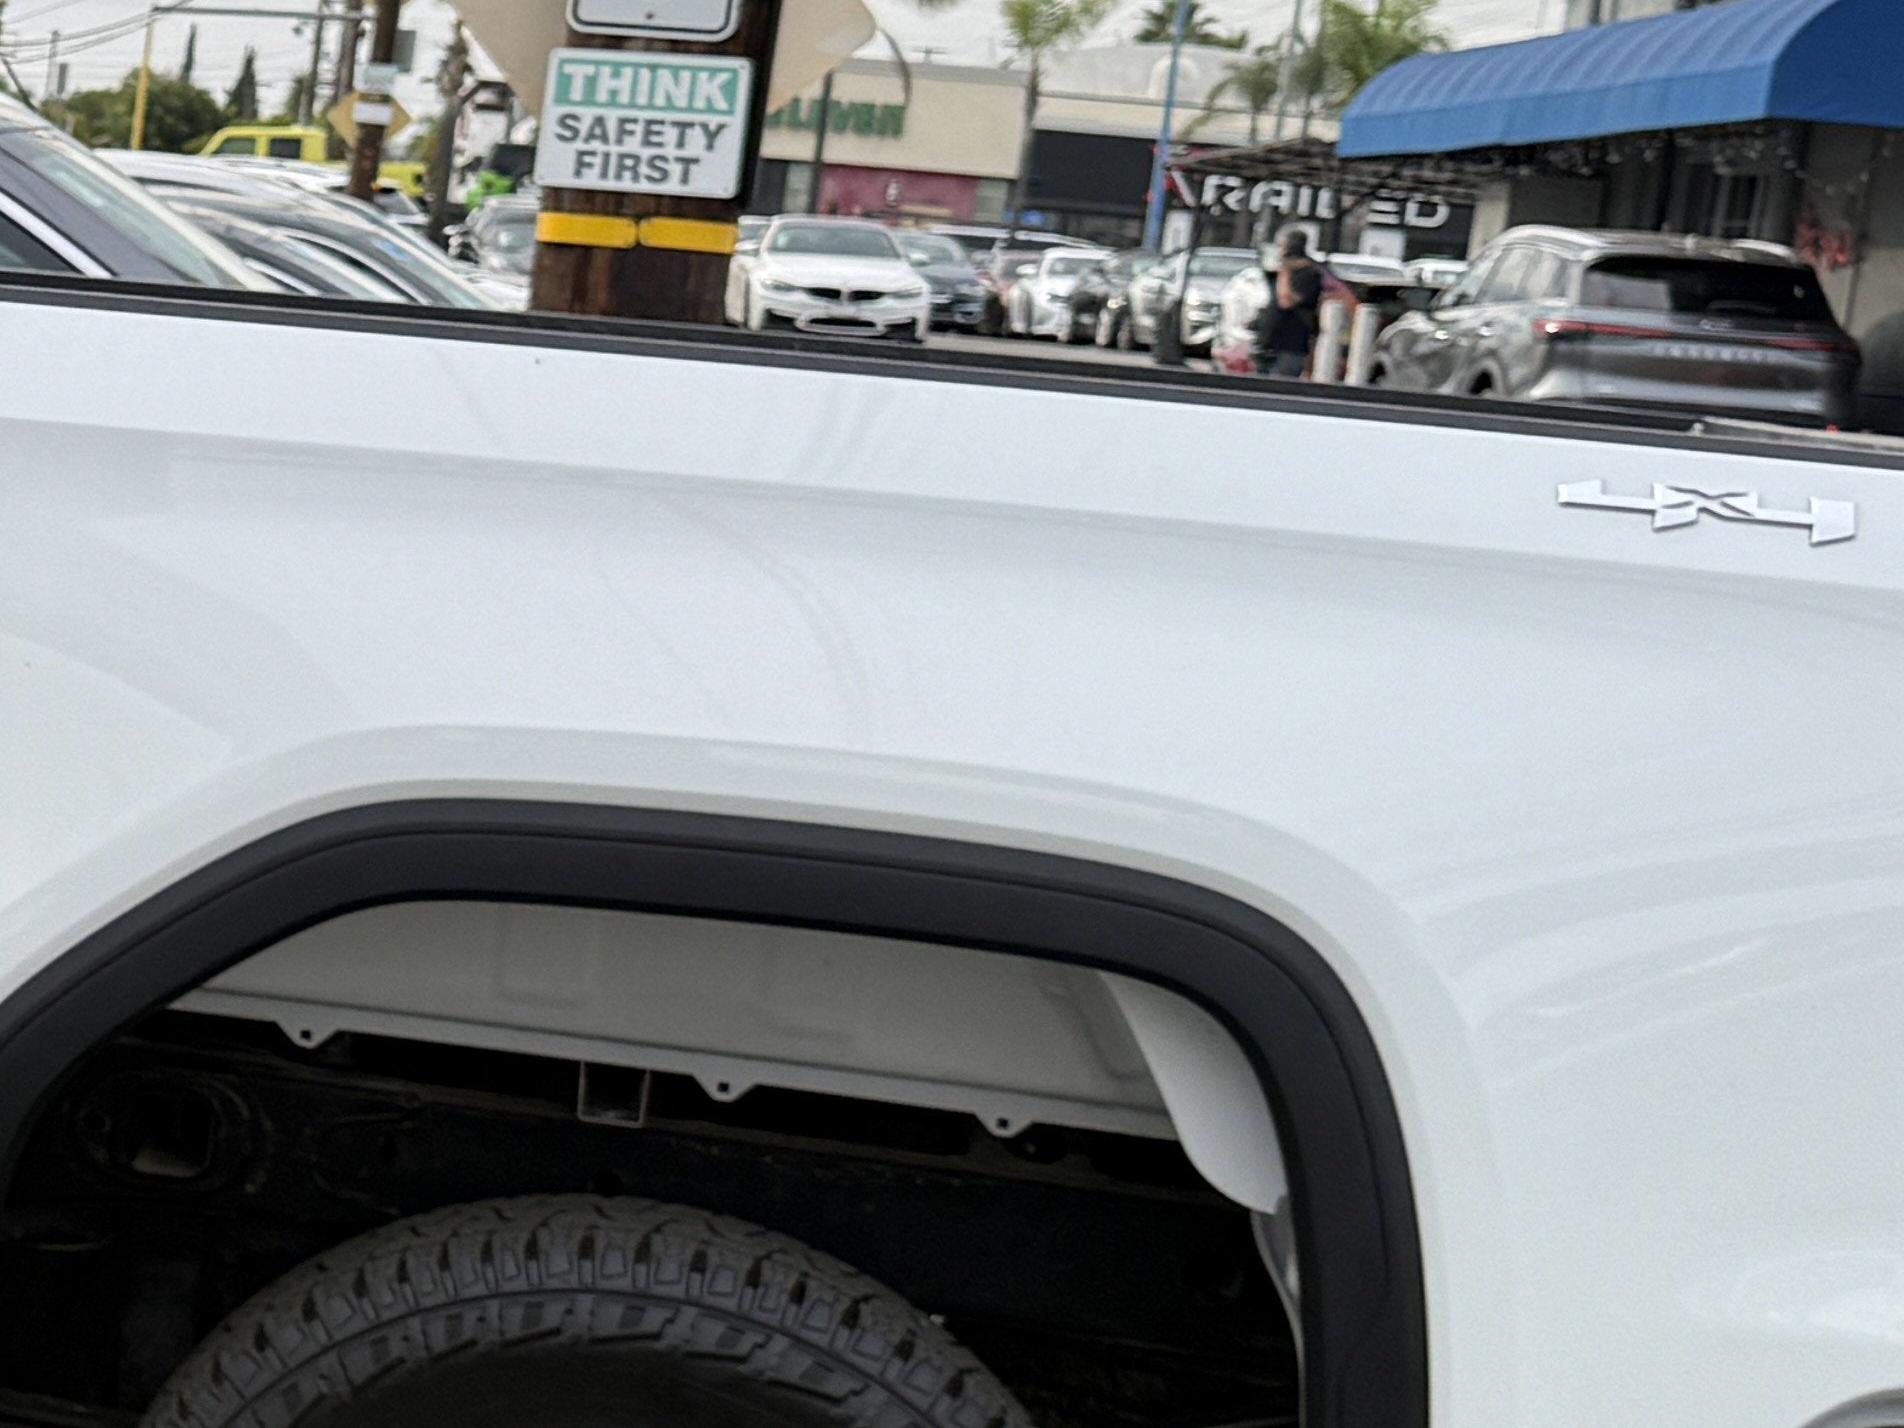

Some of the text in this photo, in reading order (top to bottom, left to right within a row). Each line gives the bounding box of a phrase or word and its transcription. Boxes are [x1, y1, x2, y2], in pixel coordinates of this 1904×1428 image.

[561, 63, 733, 112] THINK
[554, 113, 727, 152] SAFETY
[573, 149, 700, 186] FIRST
